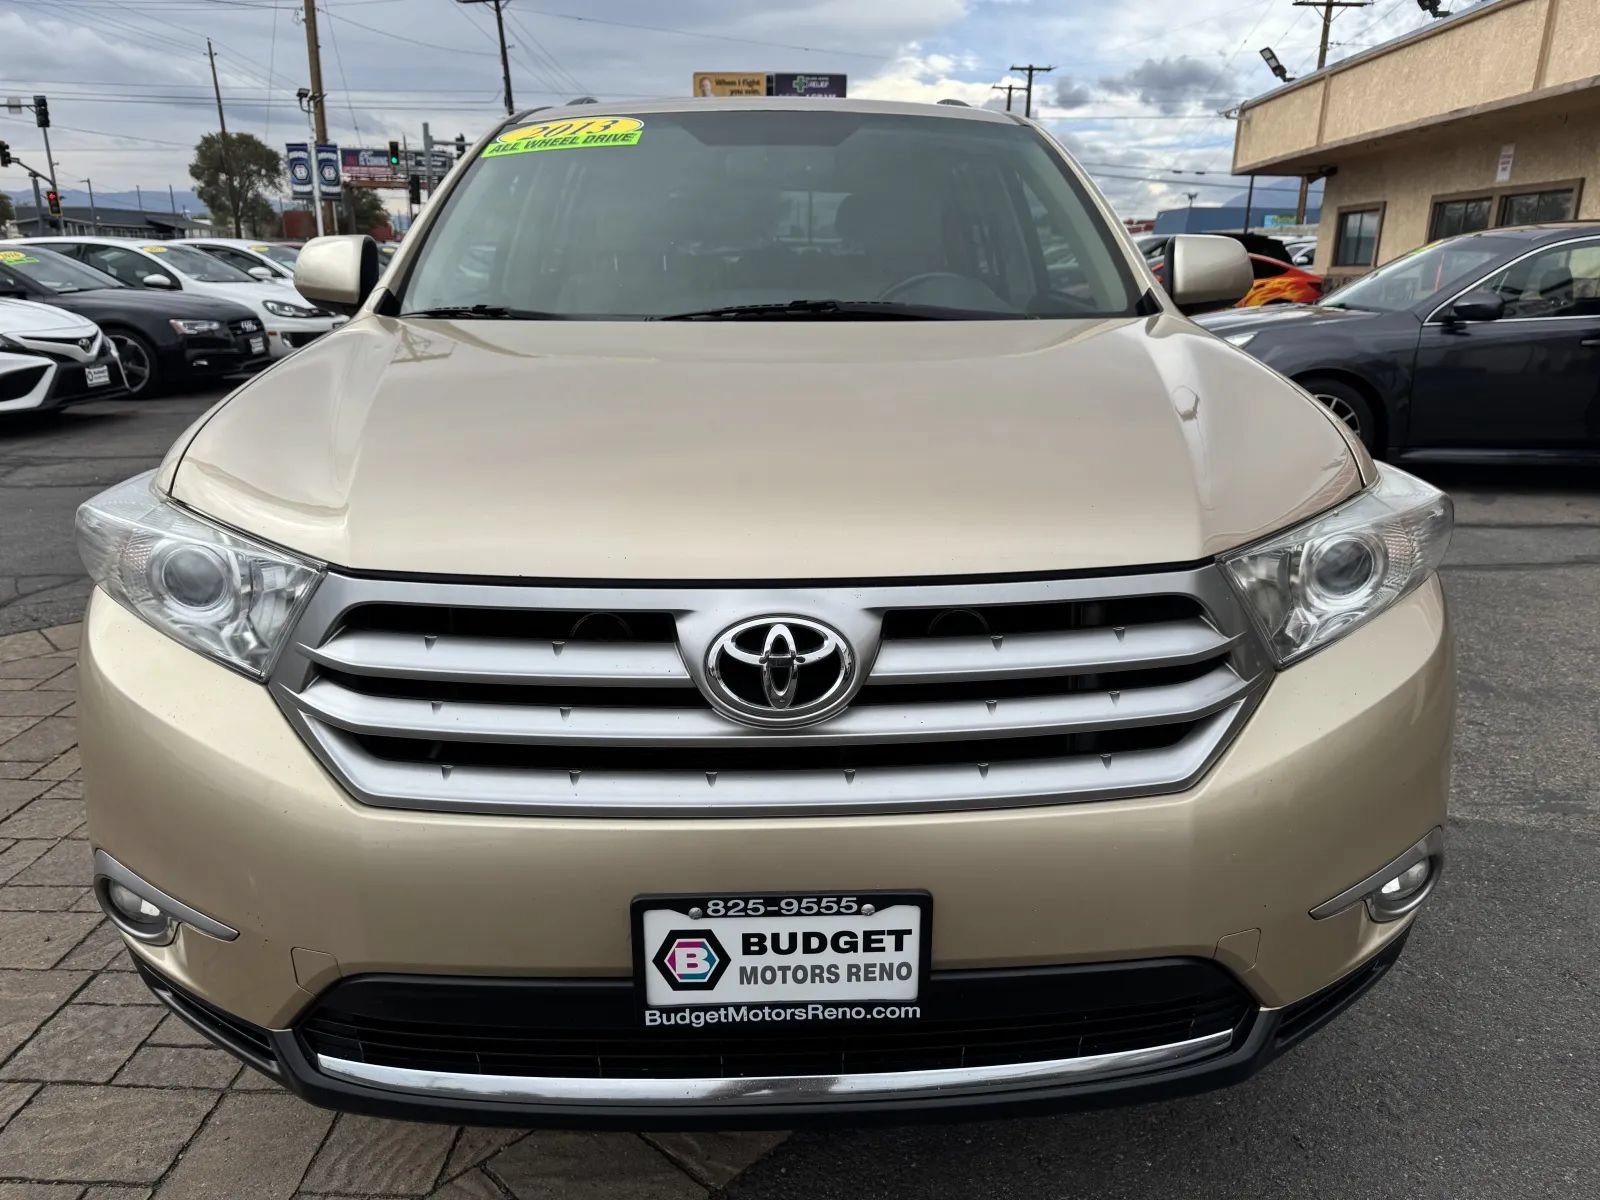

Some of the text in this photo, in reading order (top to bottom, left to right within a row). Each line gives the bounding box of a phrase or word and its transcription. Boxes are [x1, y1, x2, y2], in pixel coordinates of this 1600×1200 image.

[516, 119, 619, 141] 2013
[488, 132, 636, 154] ALL WHEEL DRIVE
[706, 897, 859, 916] 825-9555
[741, 928, 913, 956] BUDGET
[674, 947, 711, 975] B
[739, 961, 913, 985] MOTORS RENO
[644, 1004, 921, 1028] BudgetMotorsReno.com
